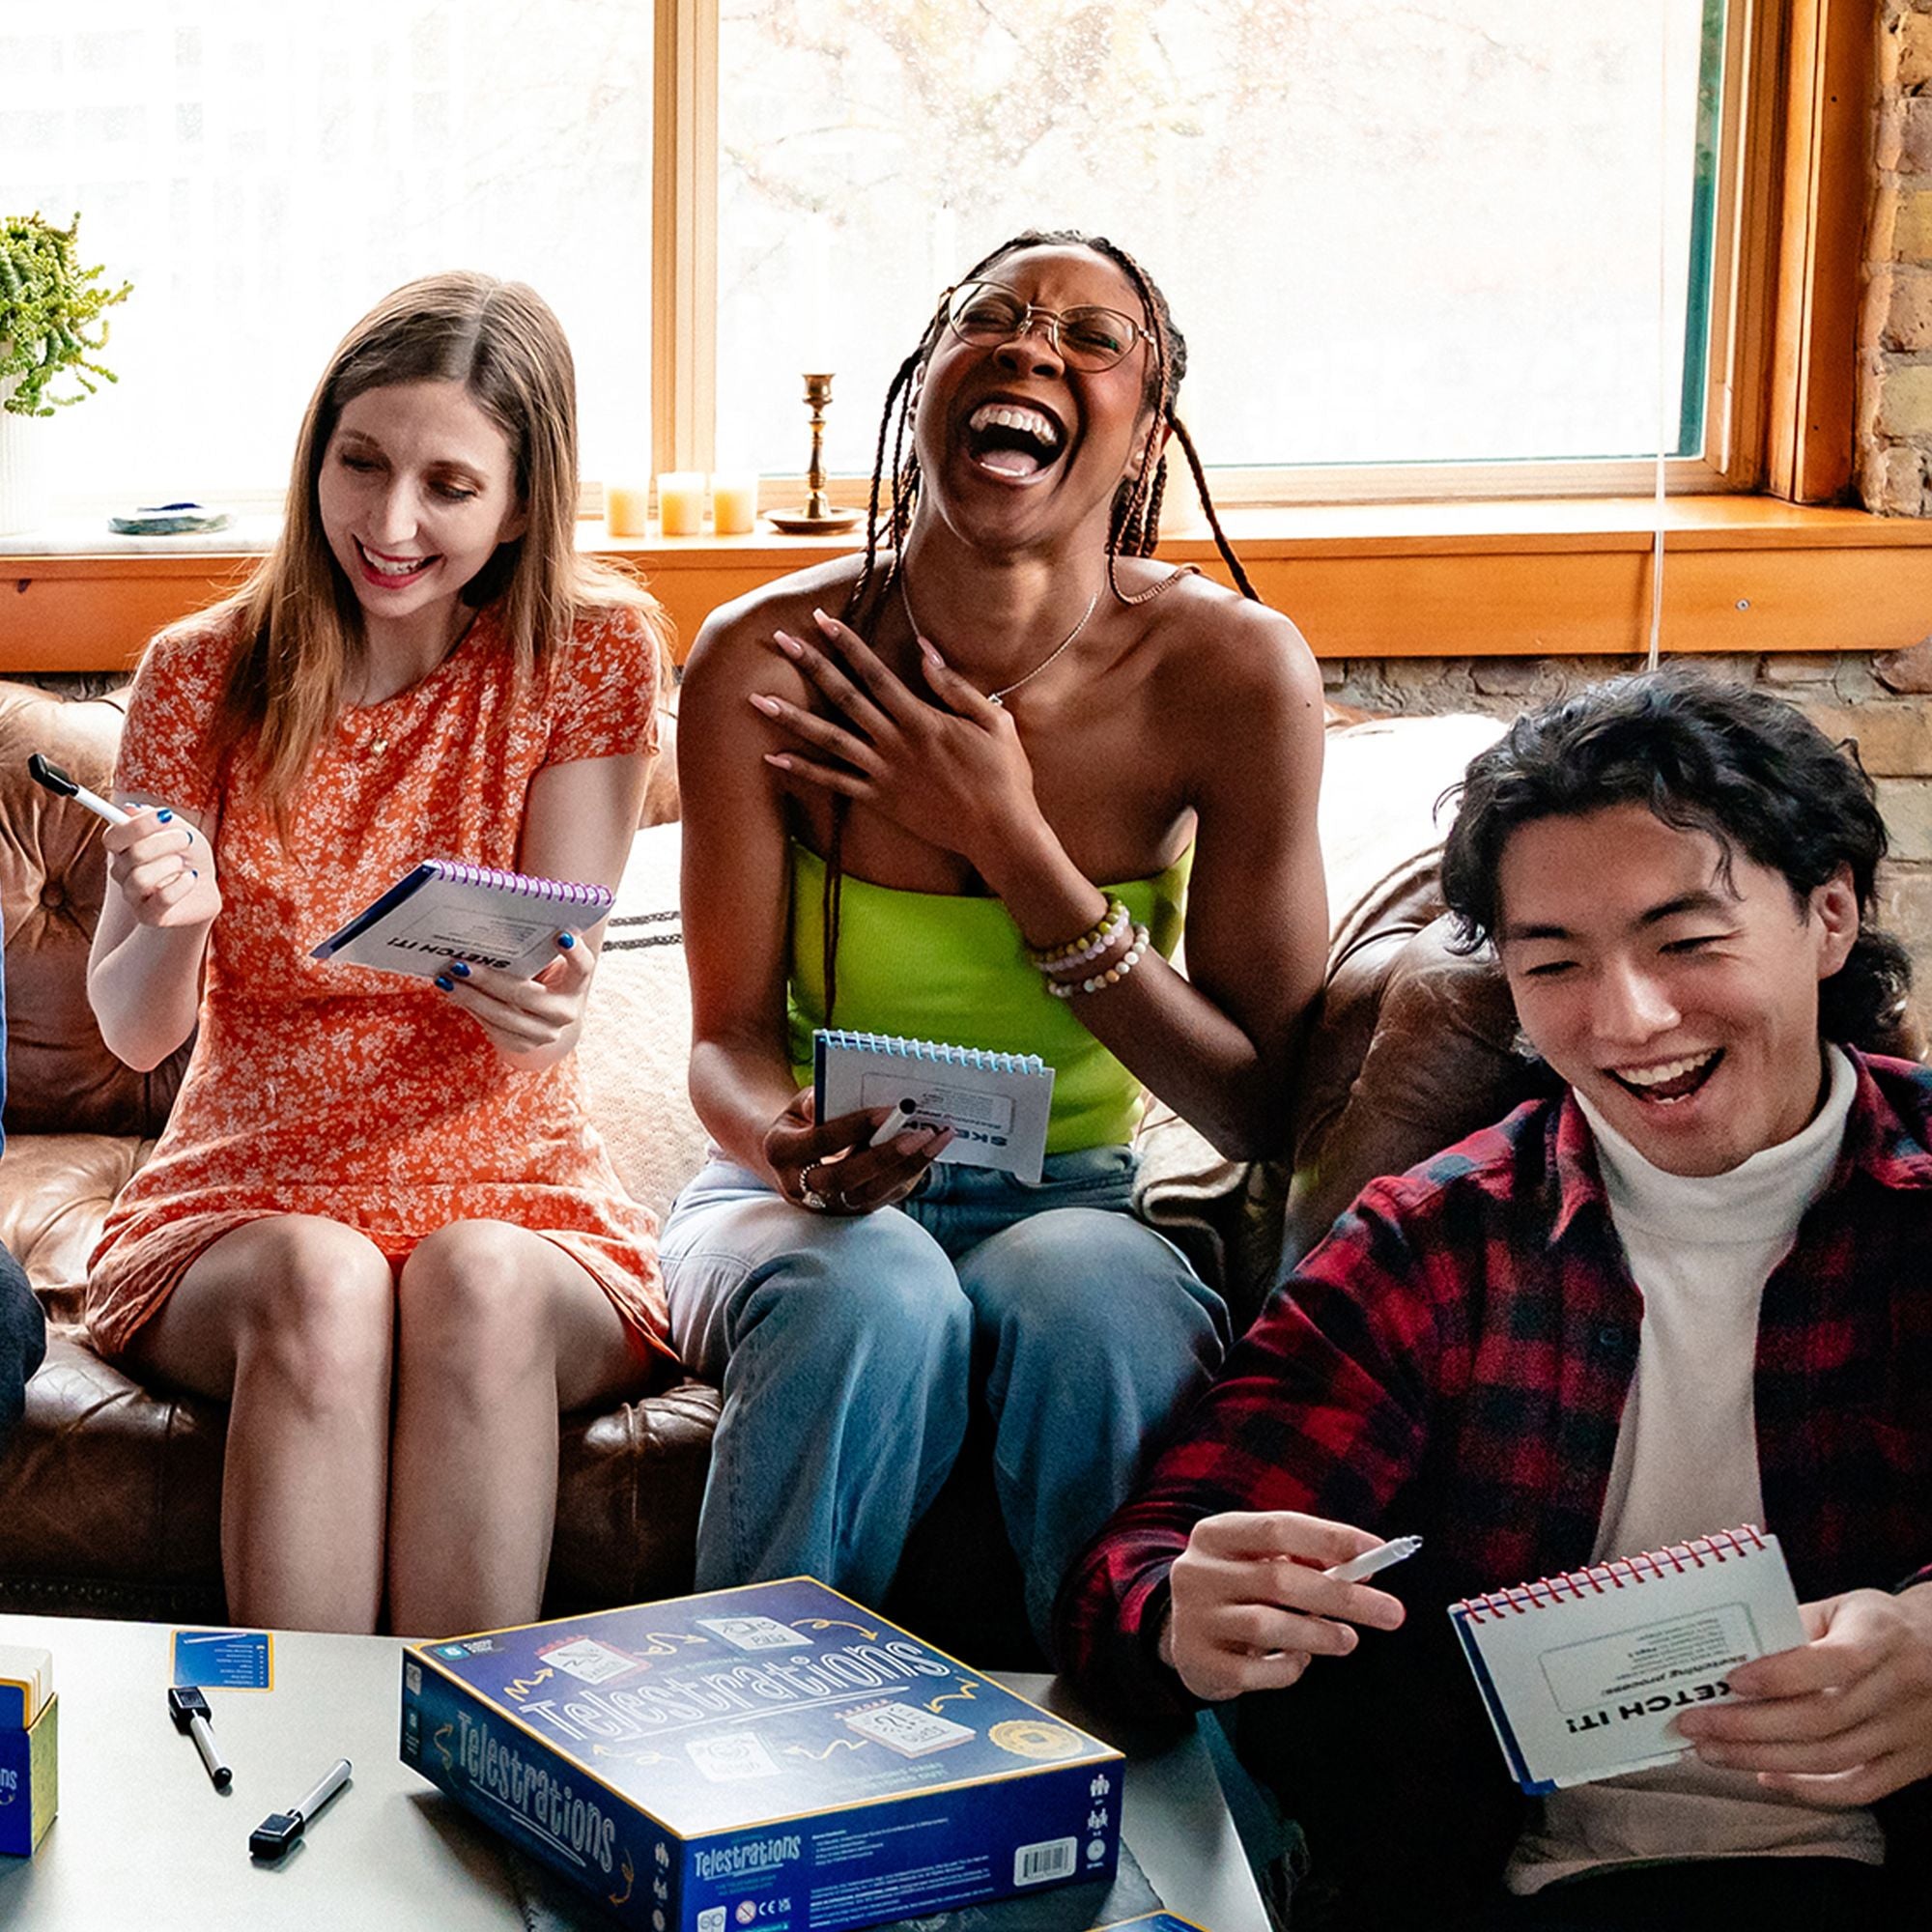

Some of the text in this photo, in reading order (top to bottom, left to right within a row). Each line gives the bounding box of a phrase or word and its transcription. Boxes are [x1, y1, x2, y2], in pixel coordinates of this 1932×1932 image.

[387, 937, 418, 950] IT!
[419, 943, 511, 968] SKETCH
[519, 1641, 951, 1740] Telestrations
[1566, 1711, 1610, 1733] IT!
[458, 1711, 615, 1873] Telestrations
[694, 1835, 802, 1877] Telestrations
